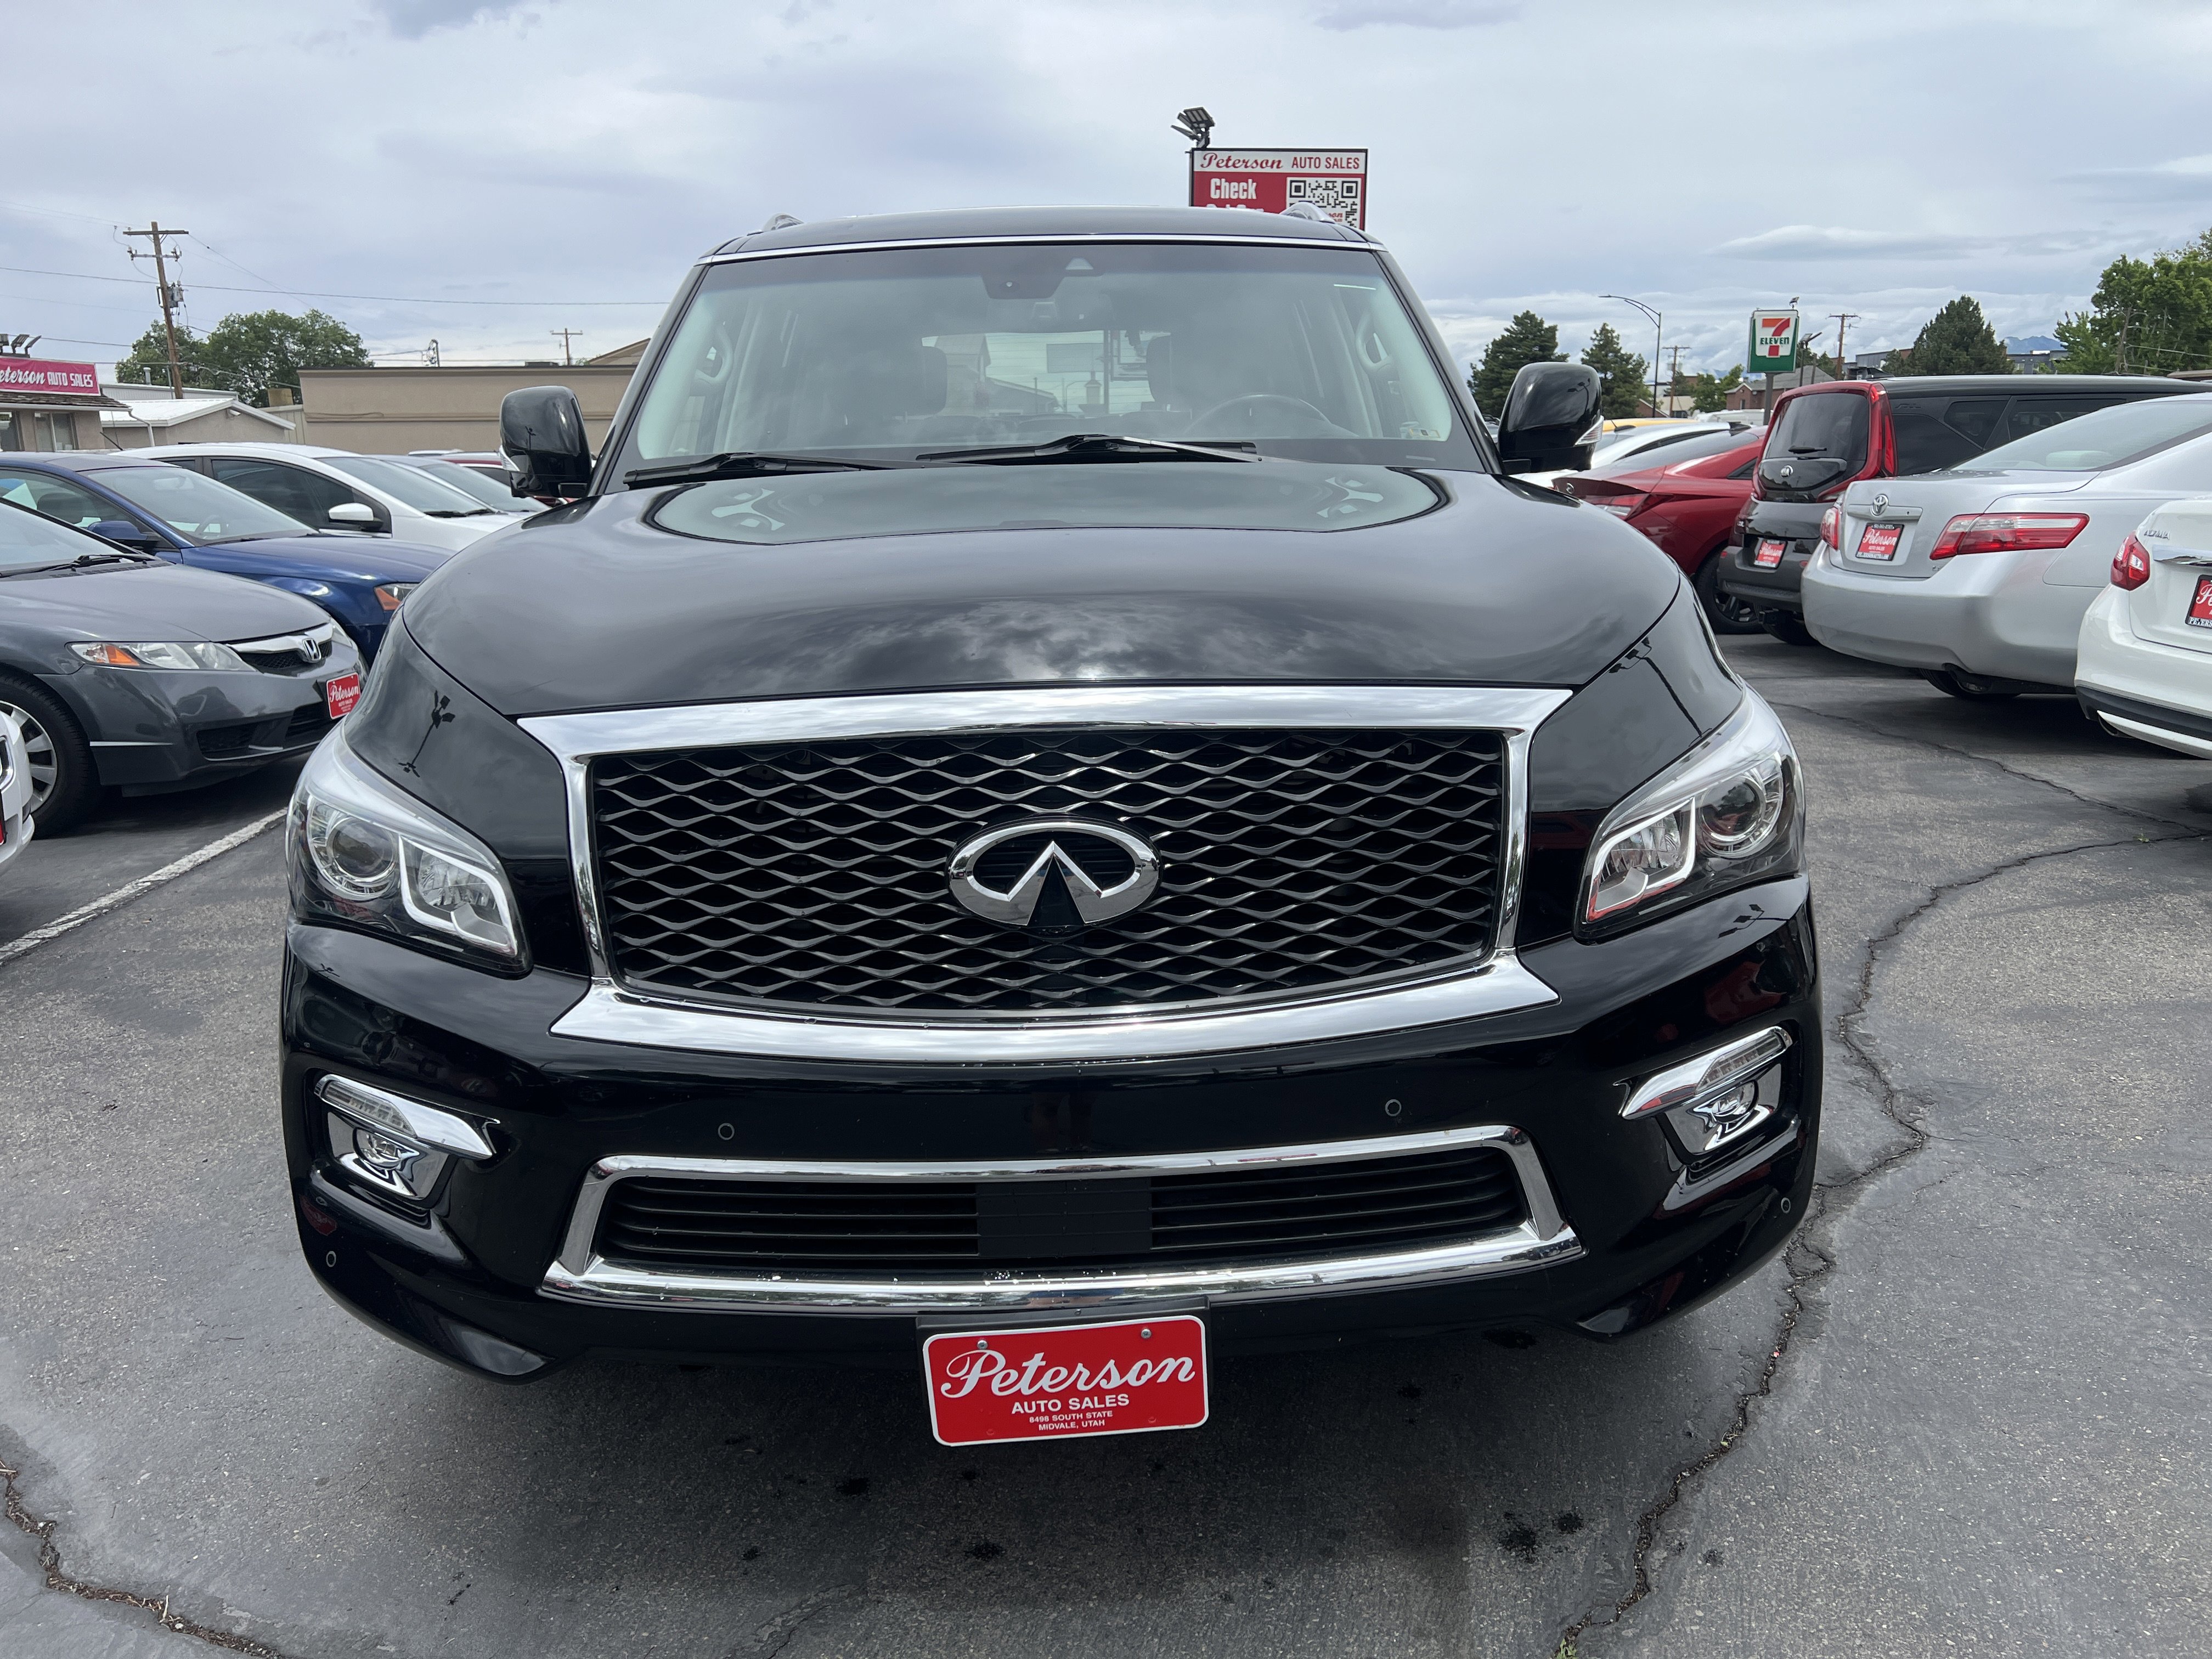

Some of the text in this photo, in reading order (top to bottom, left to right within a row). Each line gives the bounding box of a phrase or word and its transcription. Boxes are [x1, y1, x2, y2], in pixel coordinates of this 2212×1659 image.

[1200, 153, 1360, 169] Peterson AUTO SALES
[1210, 178, 1257, 199] Check
[1762, 317, 1790, 356] 7
[47, 371, 68, 386] AUTO
[70, 373, 93, 387] SALES
[1863, 528, 1897, 545] Peterson
[329, 685, 359, 703] Peterson
[940, 1349, 1196, 1398] Peterson
[1011, 1393, 1130, 1414] AUTO SALES
[1052, 1413, 1084, 1422] SOUTH
[1086, 1410, 1113, 1419] STATE
[1038, 1419, 1105, 1431] MIDVALE, UTAH
